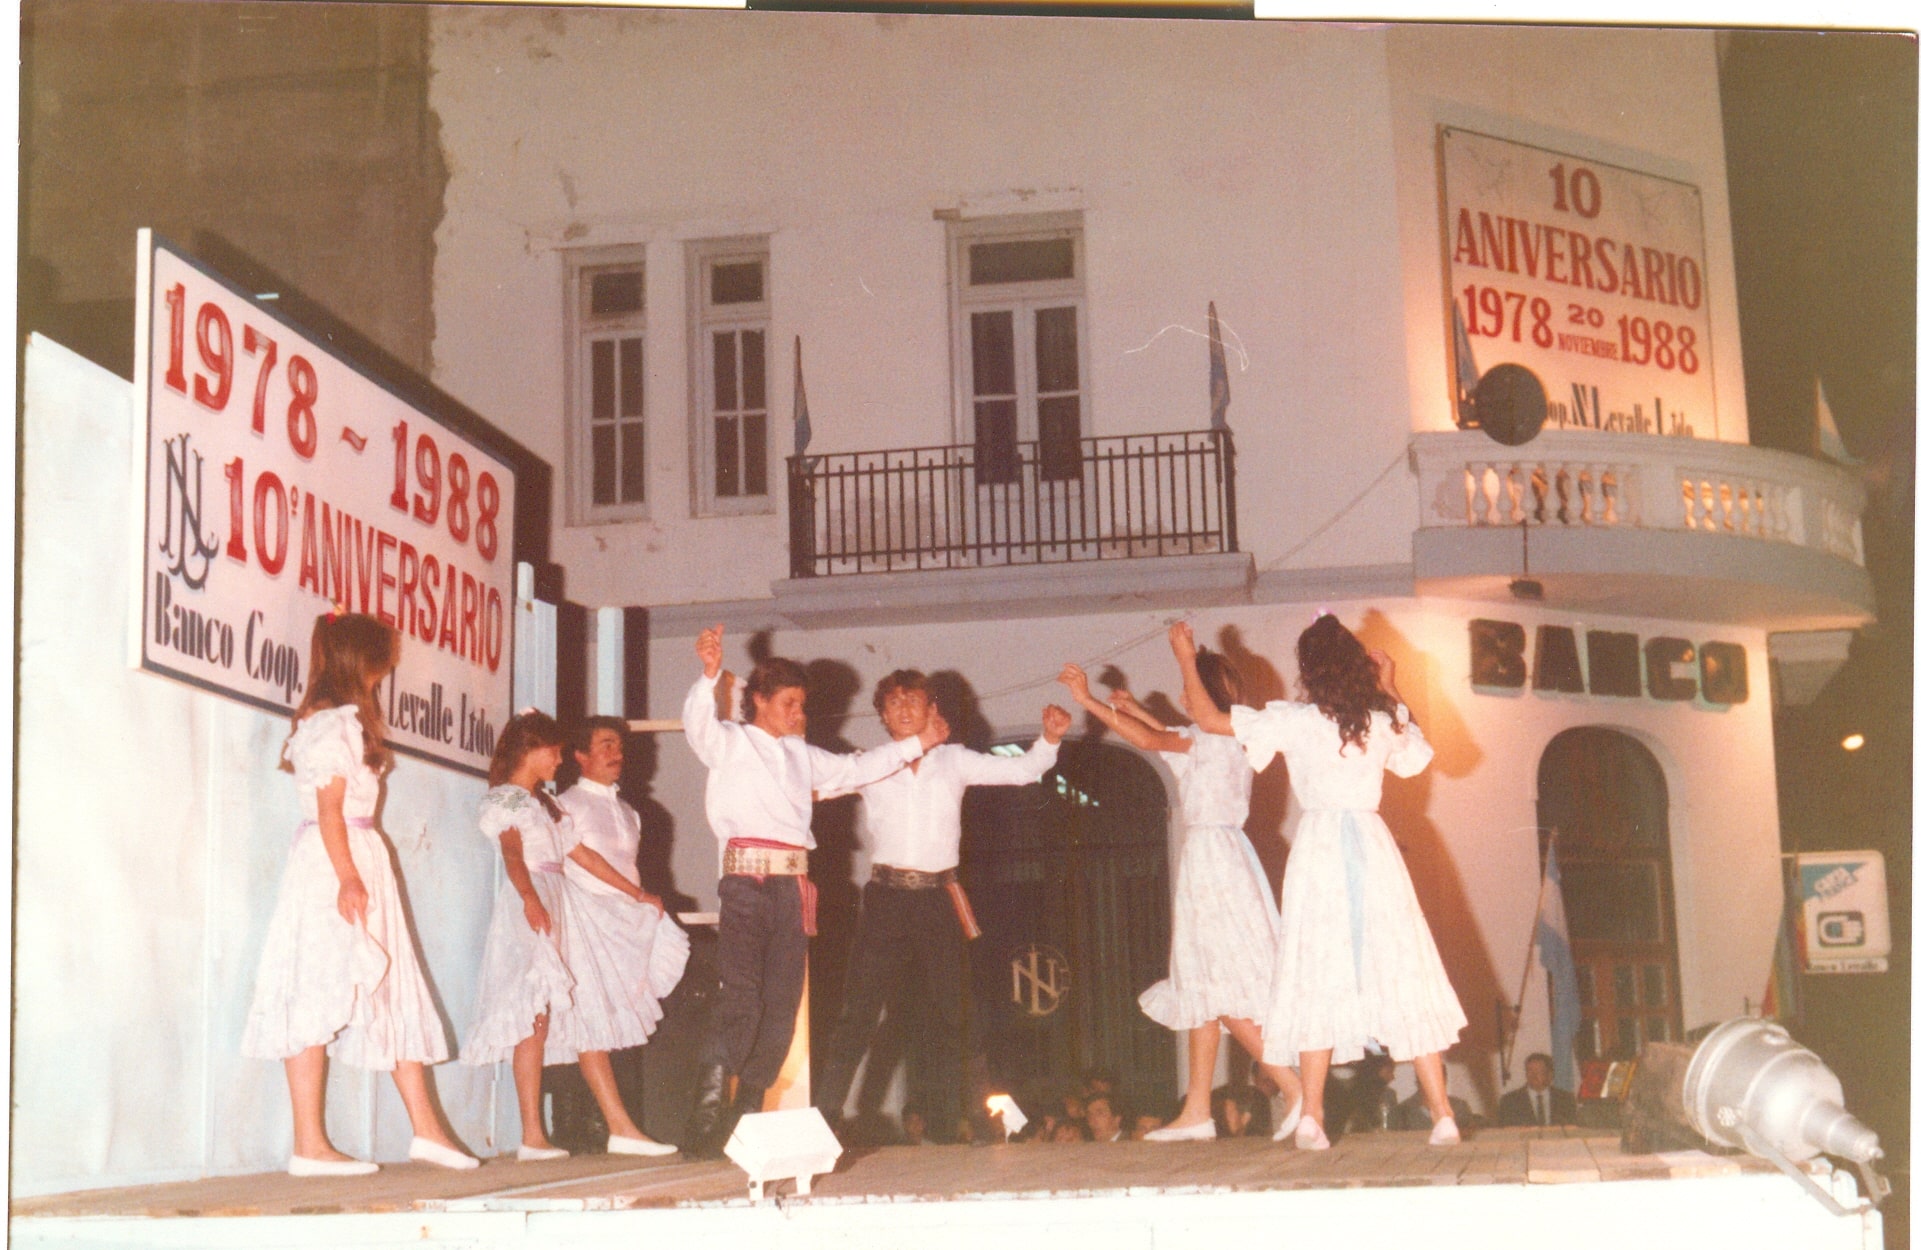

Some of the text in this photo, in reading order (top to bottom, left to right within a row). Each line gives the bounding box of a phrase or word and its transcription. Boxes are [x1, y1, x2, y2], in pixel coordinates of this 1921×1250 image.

[1549, 162, 1602, 219] 10
[1454, 207, 1701, 311] ANIVERSARIO
[1463, 283, 1699, 375] 1978 20 1988
[164, 281, 319, 462] 1978
[390, 419, 500, 562] 1988
[299, 491, 502, 673] ANIVERSARIO
[155, 571, 494, 757] Banco Coop. Levalle Ltdo
[1469, 618, 1750, 704] BANCO
